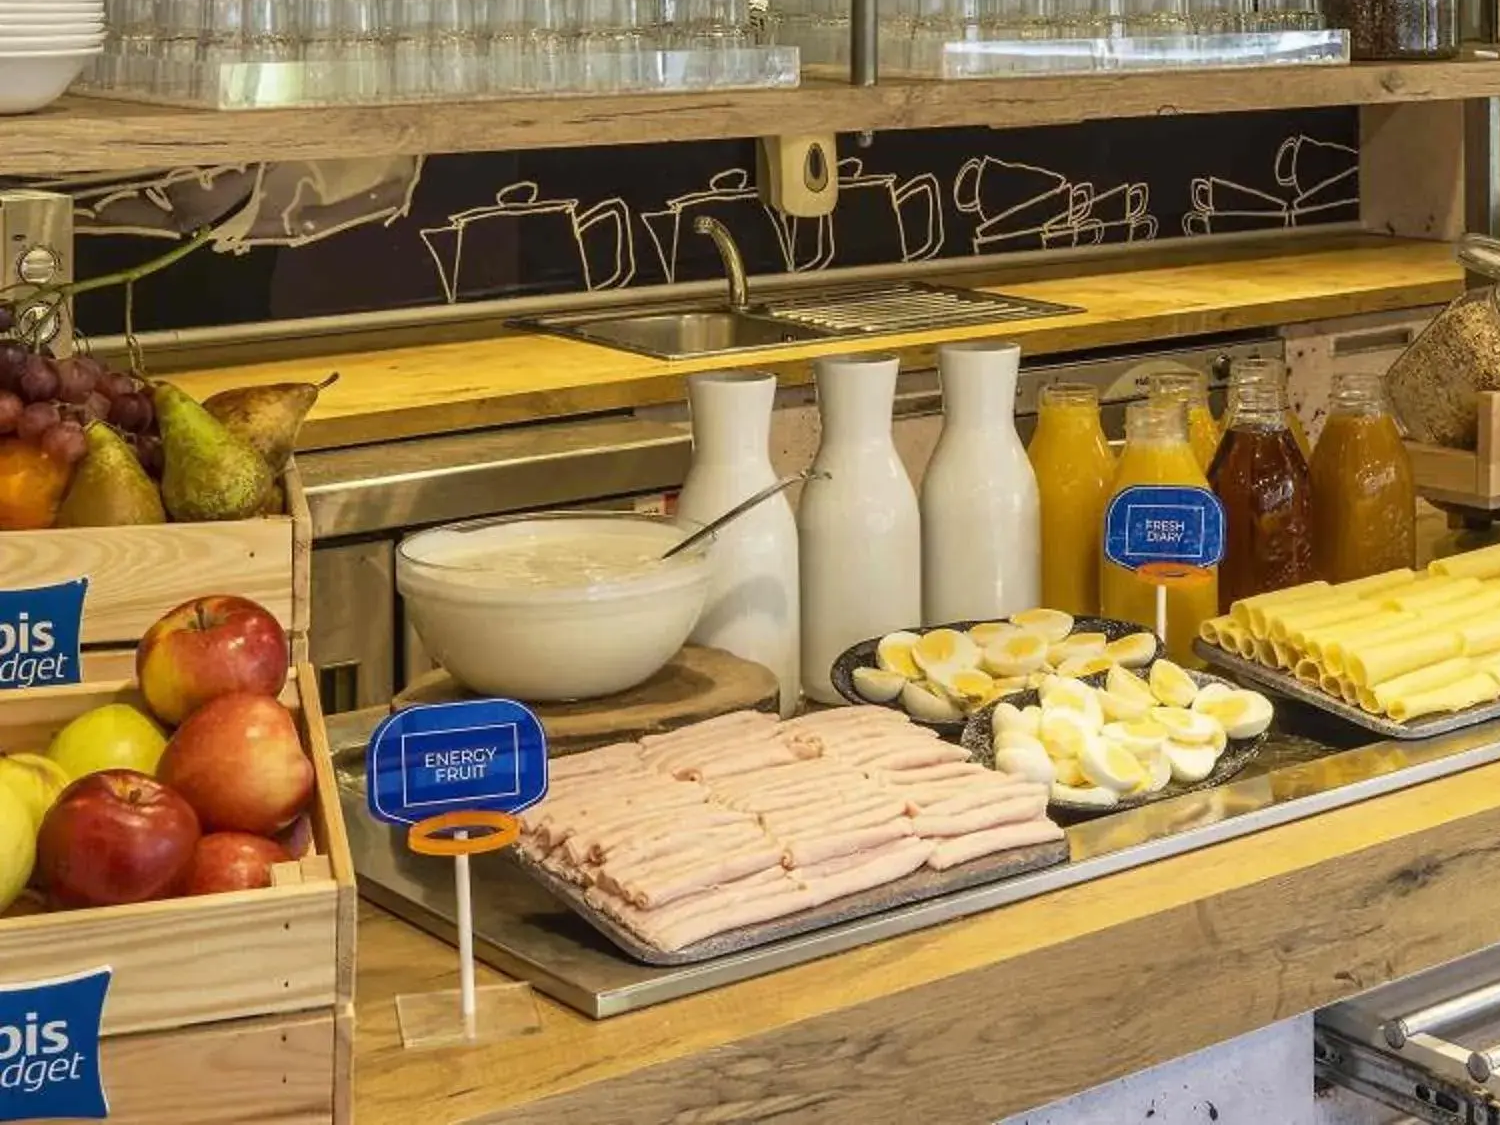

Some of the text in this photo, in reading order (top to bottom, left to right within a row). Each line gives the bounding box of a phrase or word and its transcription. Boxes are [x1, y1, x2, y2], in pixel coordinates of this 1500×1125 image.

[1145, 519, 1185, 531] FRESH
[1146, 531, 1184, 543] DIARY
[424, 746, 497, 768] ENERGY
[435, 764, 488, 784] FRUIT
